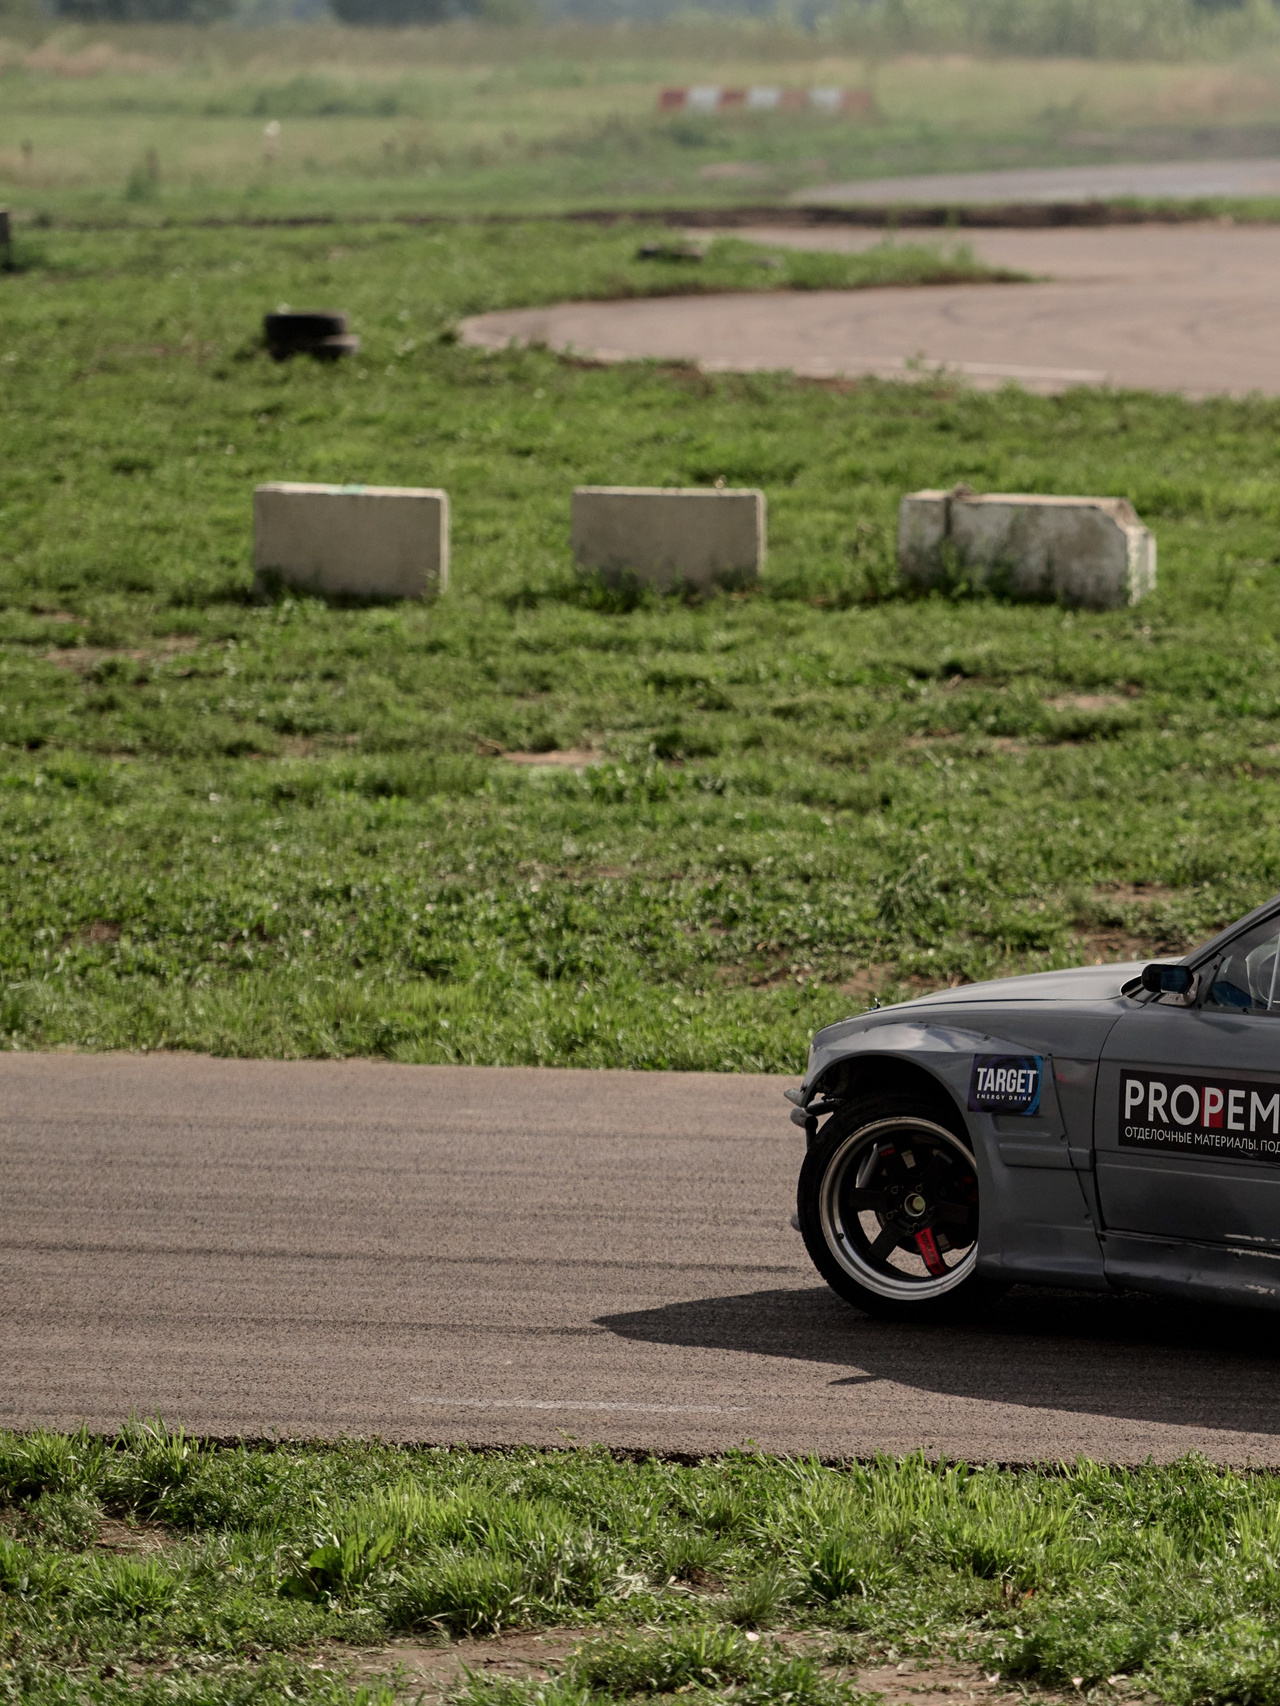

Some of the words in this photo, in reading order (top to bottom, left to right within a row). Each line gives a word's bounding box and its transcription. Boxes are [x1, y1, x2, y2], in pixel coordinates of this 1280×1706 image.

[977, 1067, 1037, 1094] TARGET
[1124, 1126, 1192, 1144] ОТДЕЛОЧНЫЕ
[1194, 1133, 1259, 1151] МАТЕРИАЛЫ.
